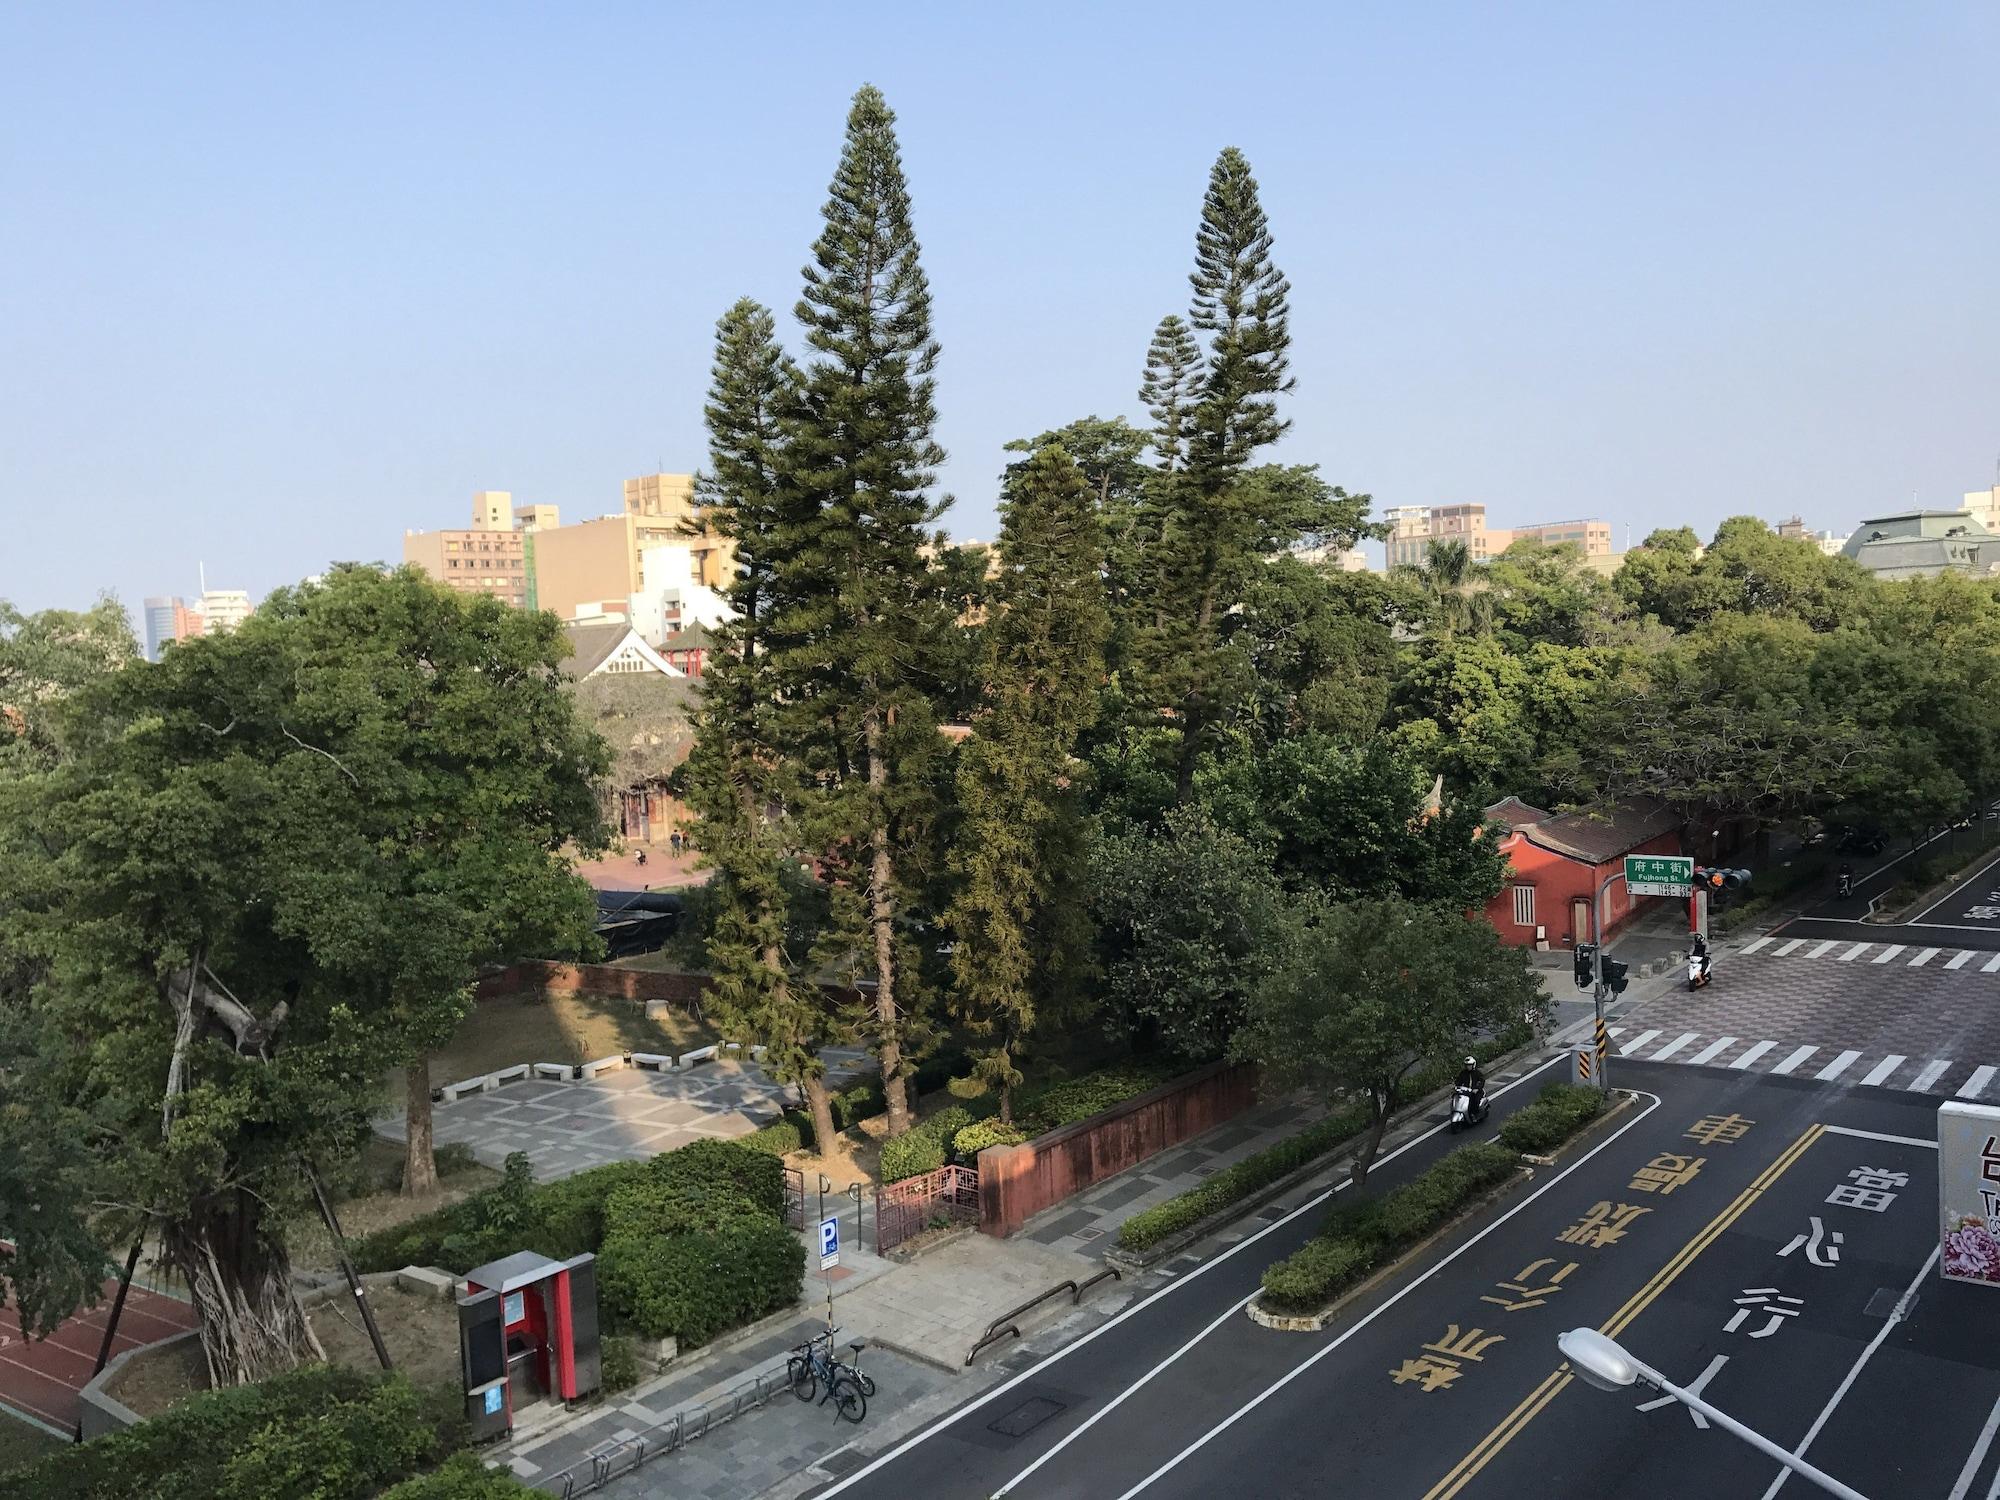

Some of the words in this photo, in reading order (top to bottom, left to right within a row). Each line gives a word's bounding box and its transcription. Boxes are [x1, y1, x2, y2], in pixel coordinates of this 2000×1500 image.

[1634, 860, 1682, 874] 府中街
[821, 1222, 836, 1256] P
[1388, 1113, 1757, 1393] 禁行機慢車
[1635, 1165, 1909, 1429] 當心行人
